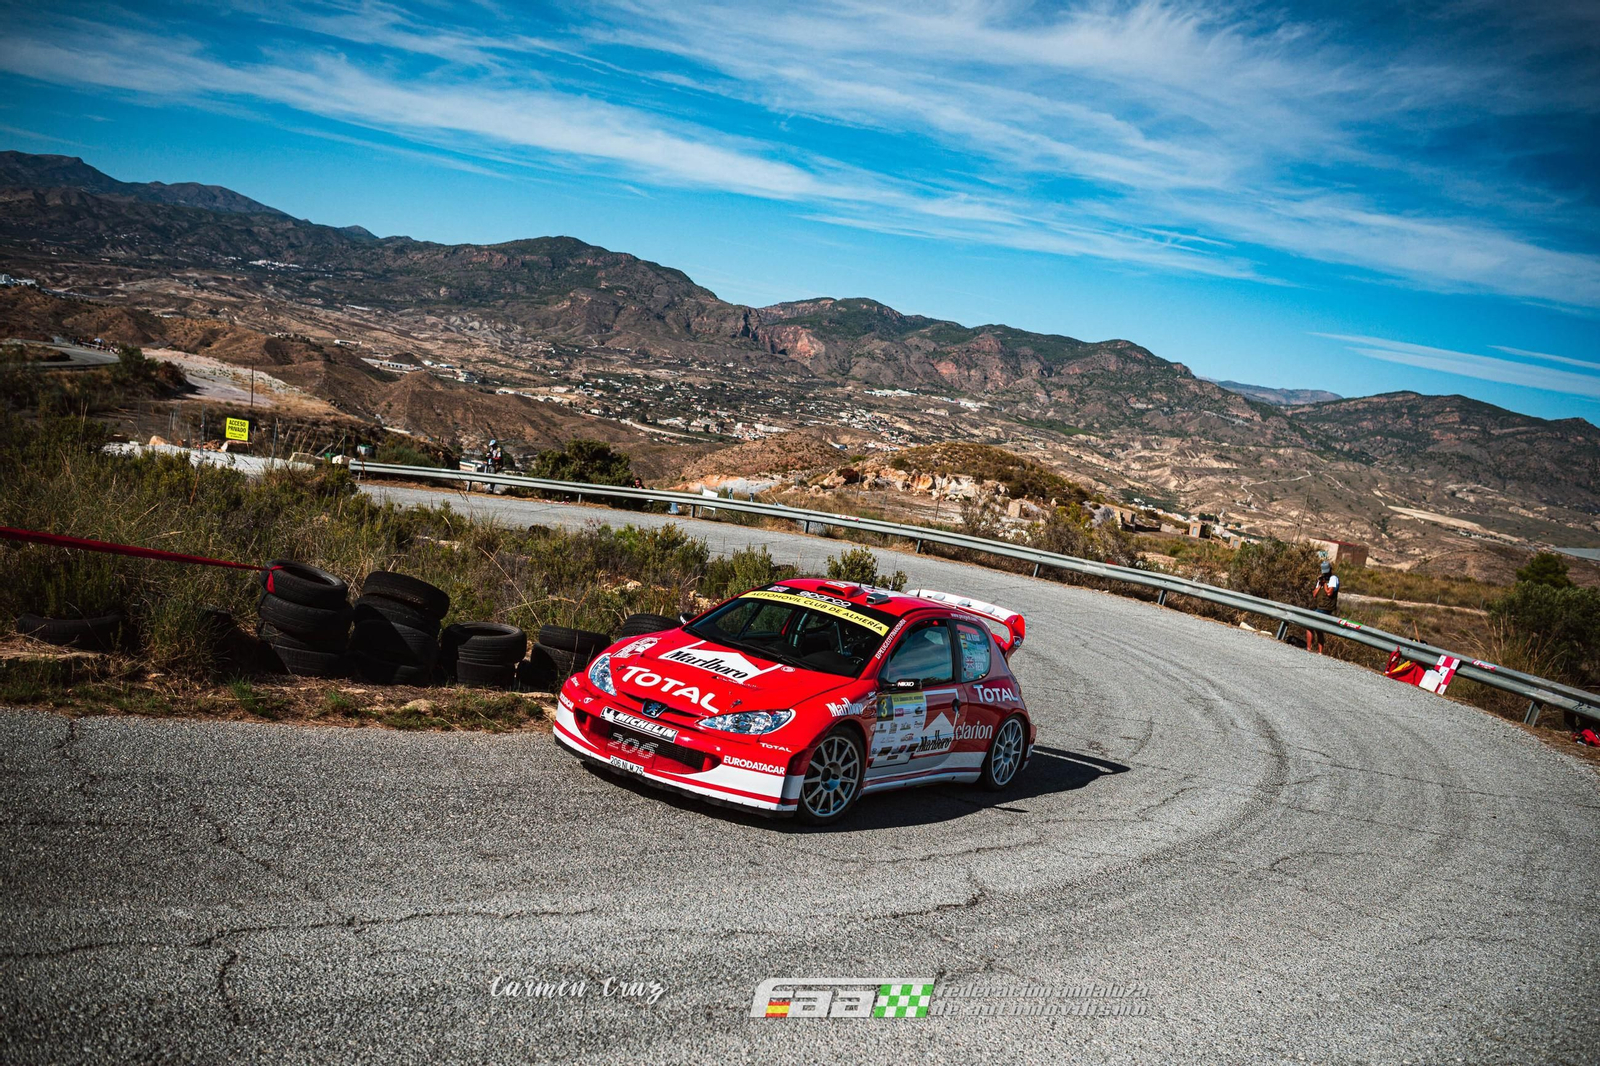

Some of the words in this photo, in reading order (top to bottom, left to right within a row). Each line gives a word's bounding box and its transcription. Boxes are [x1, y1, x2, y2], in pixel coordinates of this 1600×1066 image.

[797, 591, 851, 608] sparco
[751, 592, 801, 603] AUTOMOVIL
[804, 599, 828, 610] CLUB
[828, 606, 842, 614] DE
[842, 612, 883, 632] ALMERÍA
[665, 650, 749, 679] Marlboro
[620, 665, 720, 714] TOTAL
[972, 684, 1018, 703] TOTAL
[825, 697, 864, 718] Marlboro
[880, 698, 888, 718] 3
[614, 712, 676, 738] MICHELIN
[955, 720, 994, 740] clarion
[607, 732, 659, 759] 206
[760, 742, 792, 753] TOTAL
[916, 730, 952, 752] Marlboro
[723, 755, 786, 775] EURODATACAR
